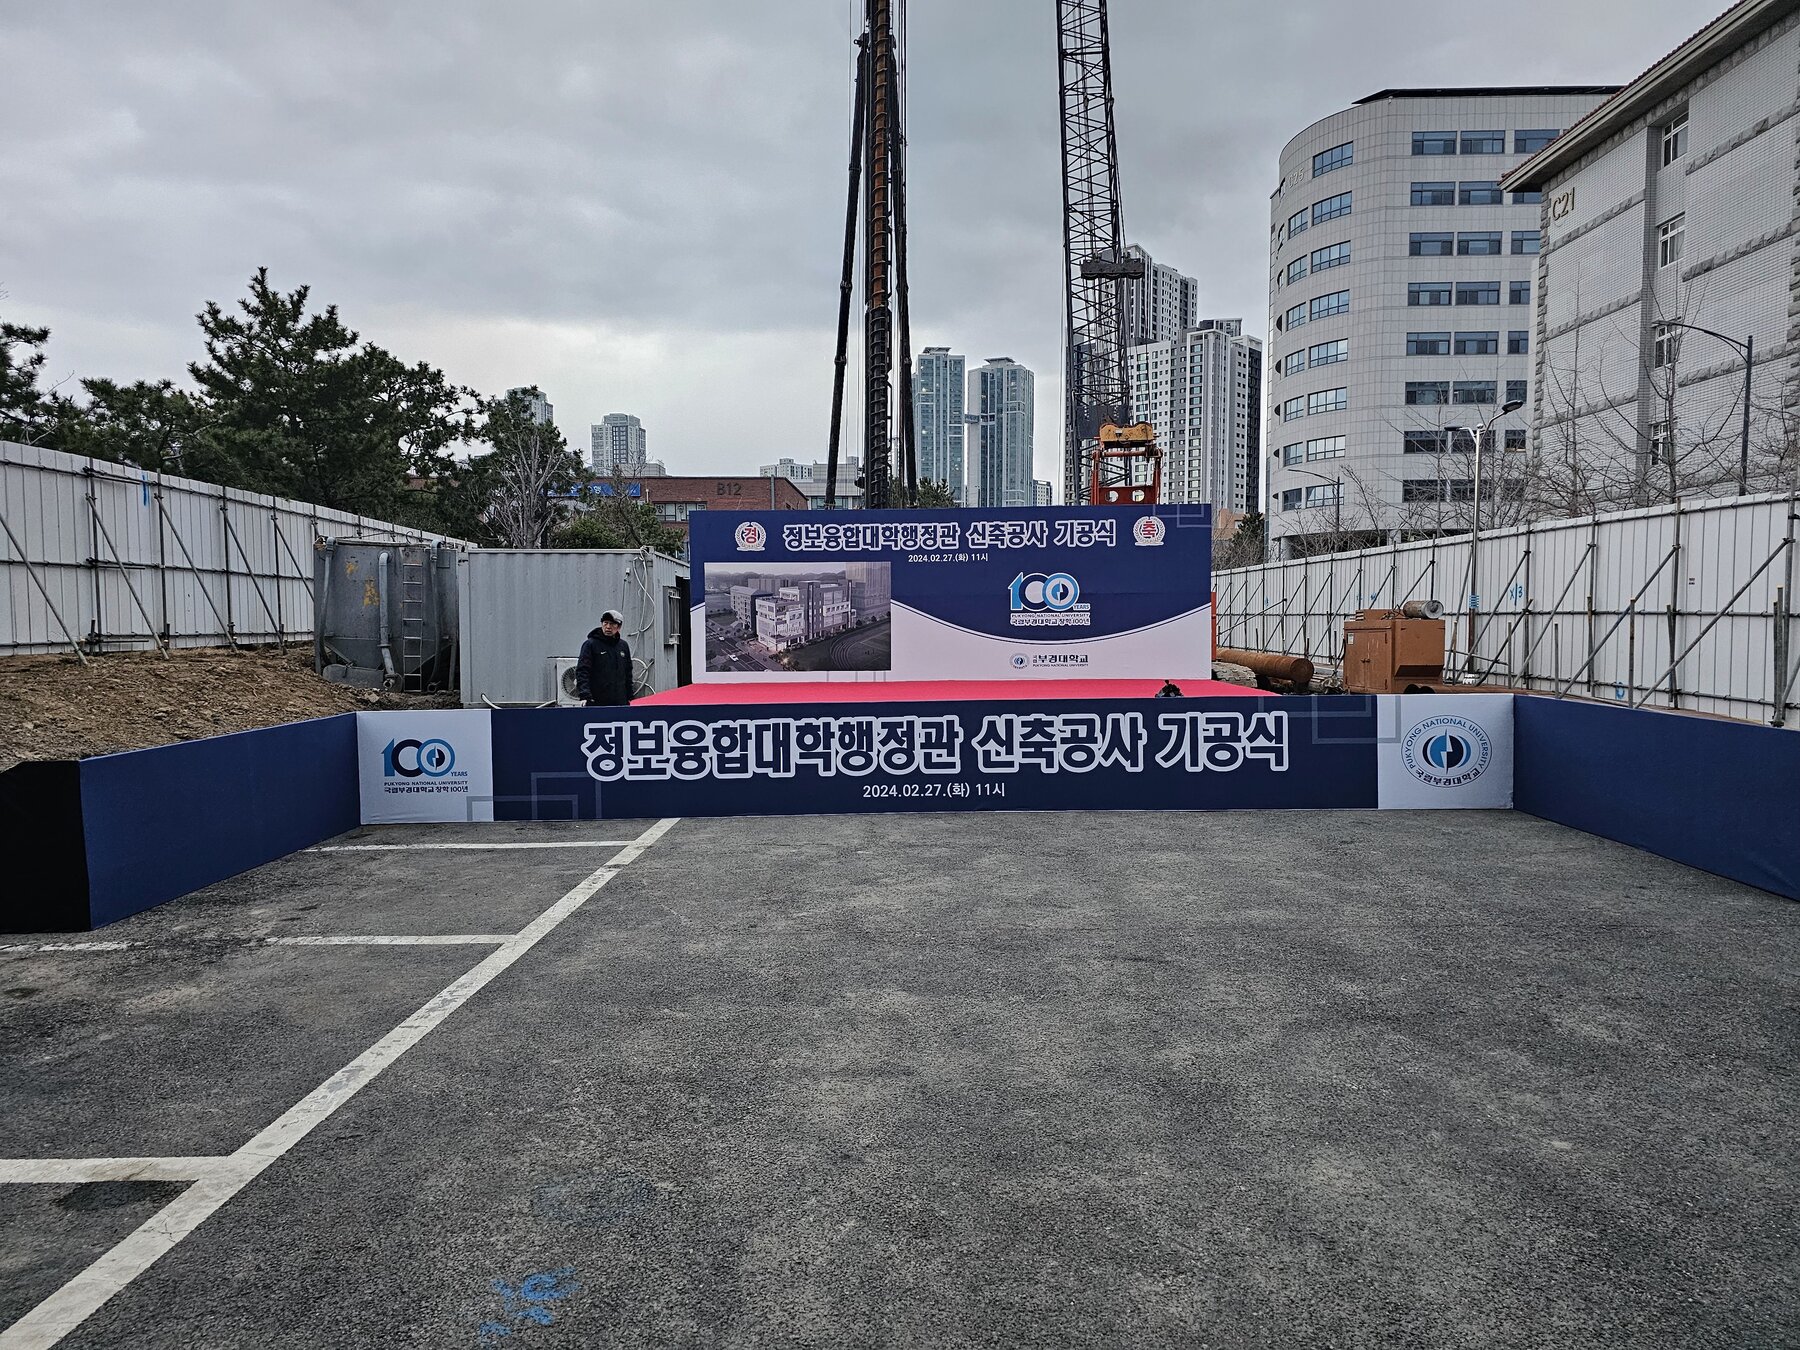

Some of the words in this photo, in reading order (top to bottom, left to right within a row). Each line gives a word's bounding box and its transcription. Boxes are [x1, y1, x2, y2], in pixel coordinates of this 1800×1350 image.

[1553, 187, 1575, 221] C21
[717, 482, 742, 496] B12
[743, 527, 757, 544] 경
[782, 522, 960, 551] 정보융합대학행정관
[966, 520, 1048, 549] 신축공사
[1053, 519, 1117, 547] 기공식
[1141, 520, 1158, 539] 축
[908, 553, 969, 563] 2024.02.27.(화)
[971, 553, 989, 562] 11시
[1008, 572, 1080, 611] 100
[1038, 654, 1089, 663] 부경대학교
[581, 715, 963, 782] 정보융합대학행정관
[971, 713, 1148, 774] 신축공사
[1155, 710, 1290, 773] 기공식
[1405, 727, 1422, 770] PUKYONG
[1422, 717, 1467, 730] NATIONAL
[1468, 724, 1489, 769] UNIVERSITY
[381, 738, 456, 777] 100
[1415, 767, 1481, 786] 국립부경대학교
[863, 782, 970, 798] 2024.02.27.(화)
[975, 782, 1005, 797] 11시
